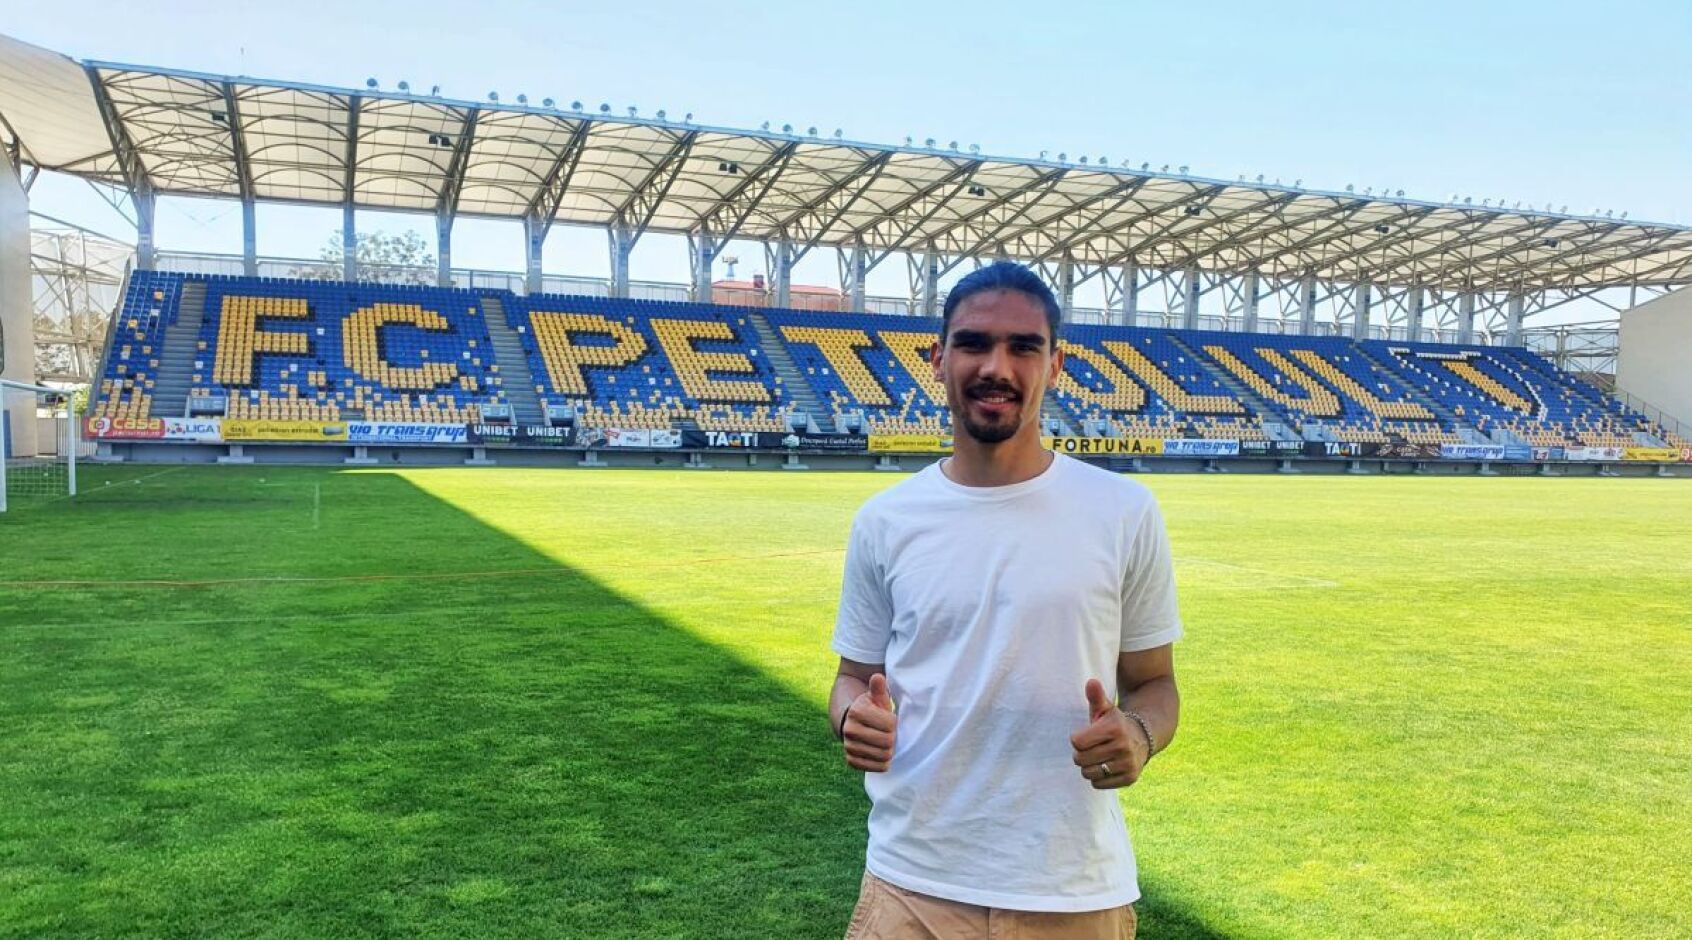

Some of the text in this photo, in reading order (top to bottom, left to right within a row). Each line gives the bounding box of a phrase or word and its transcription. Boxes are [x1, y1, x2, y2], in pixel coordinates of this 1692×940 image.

[213, 295, 458, 390] FC
[185, 424, 214, 433] LIGA
[474, 425, 571, 437] UNIBET UNIBET
[1242, 441, 1305, 450] UNIBET UNIBET
